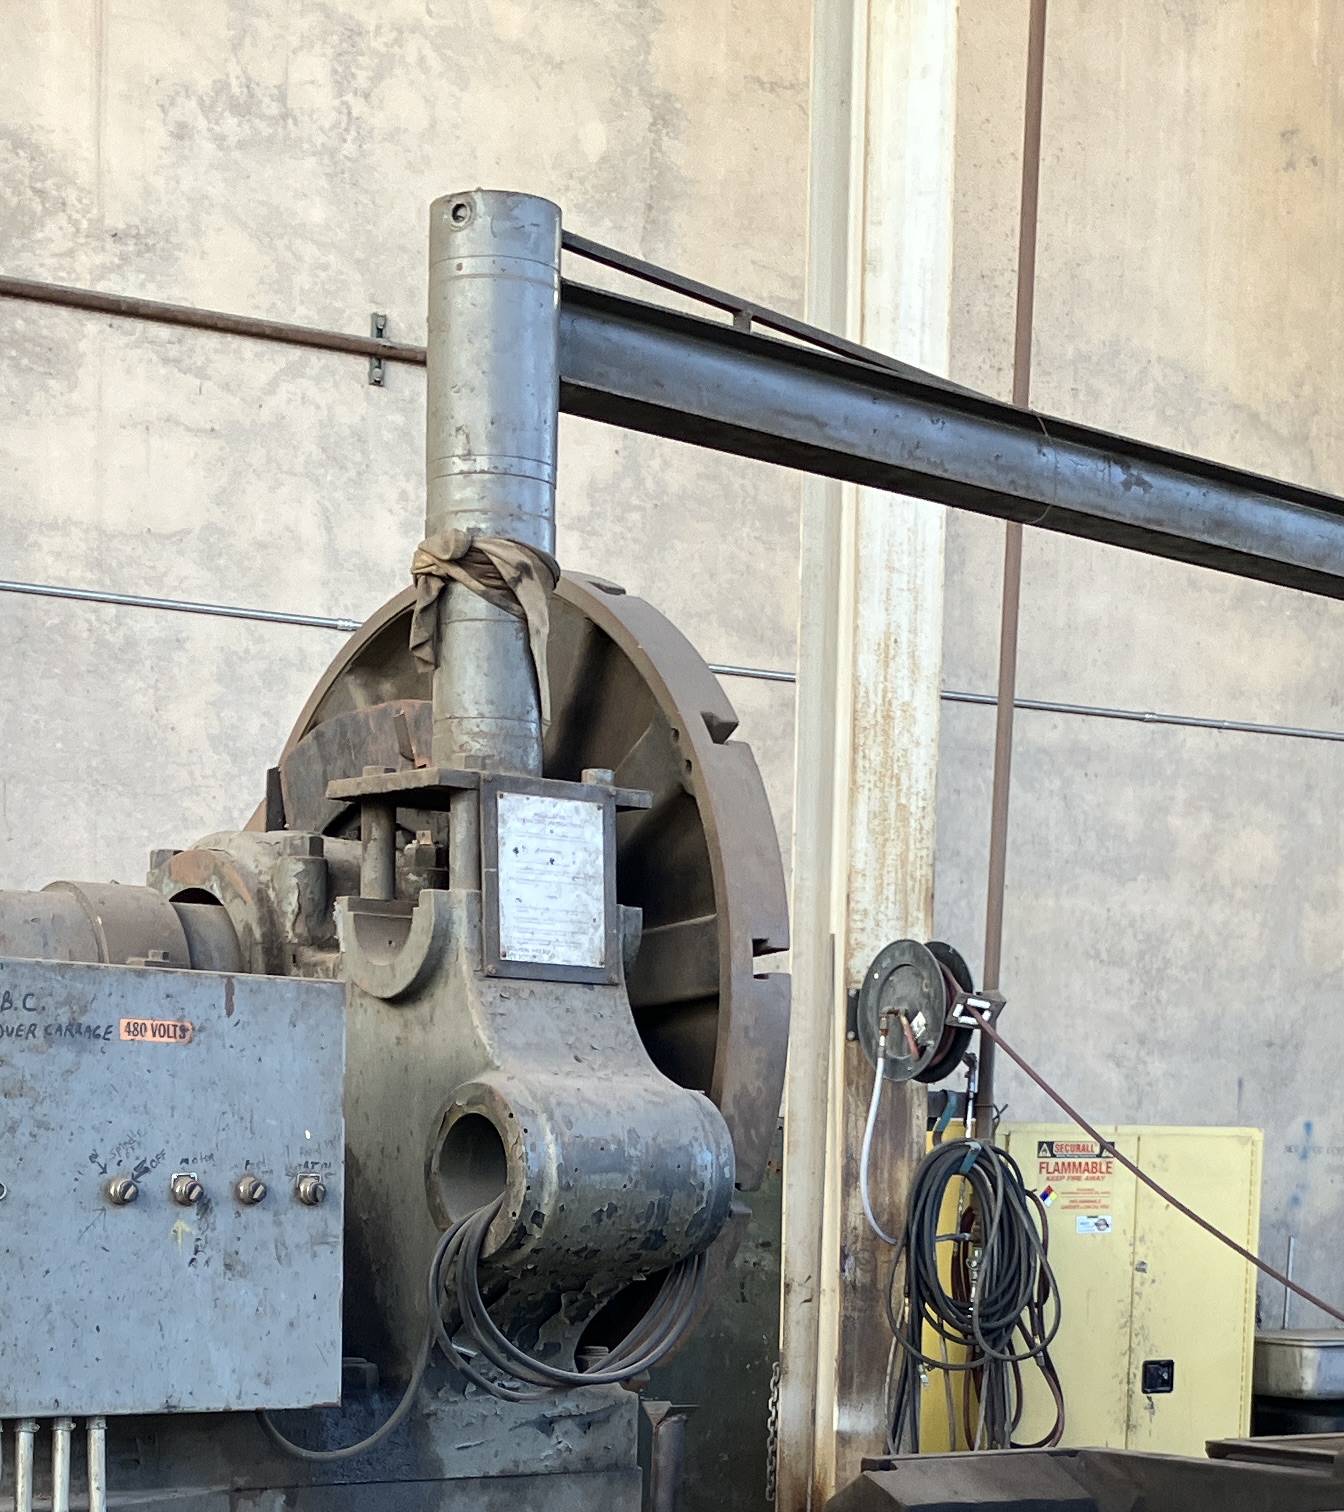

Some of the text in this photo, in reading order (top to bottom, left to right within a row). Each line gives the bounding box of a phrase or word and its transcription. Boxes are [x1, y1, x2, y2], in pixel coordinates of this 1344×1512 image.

[124, 1021, 188, 1039] 480 VOLTS
[1054, 1143, 1096, 1153] SECURALL
[1039, 1161, 1113, 1174] FLAMMABLE
